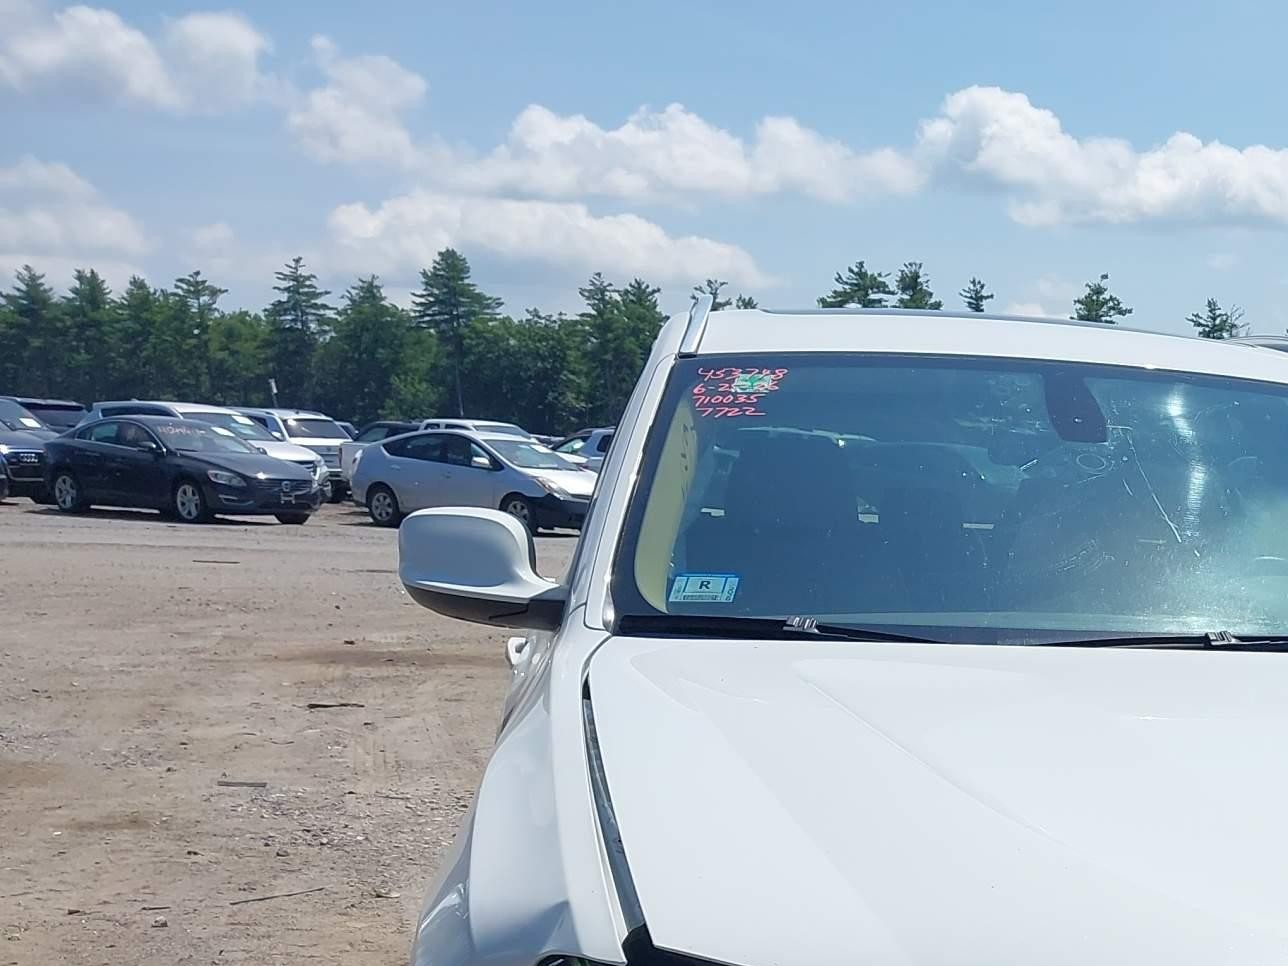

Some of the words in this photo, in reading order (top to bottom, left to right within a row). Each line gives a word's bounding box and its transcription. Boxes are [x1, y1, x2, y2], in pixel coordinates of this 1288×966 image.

[692, 394, 767, 407] 710035
[696, 406, 767, 418] 7722
[699, 581, 711, 589] R
